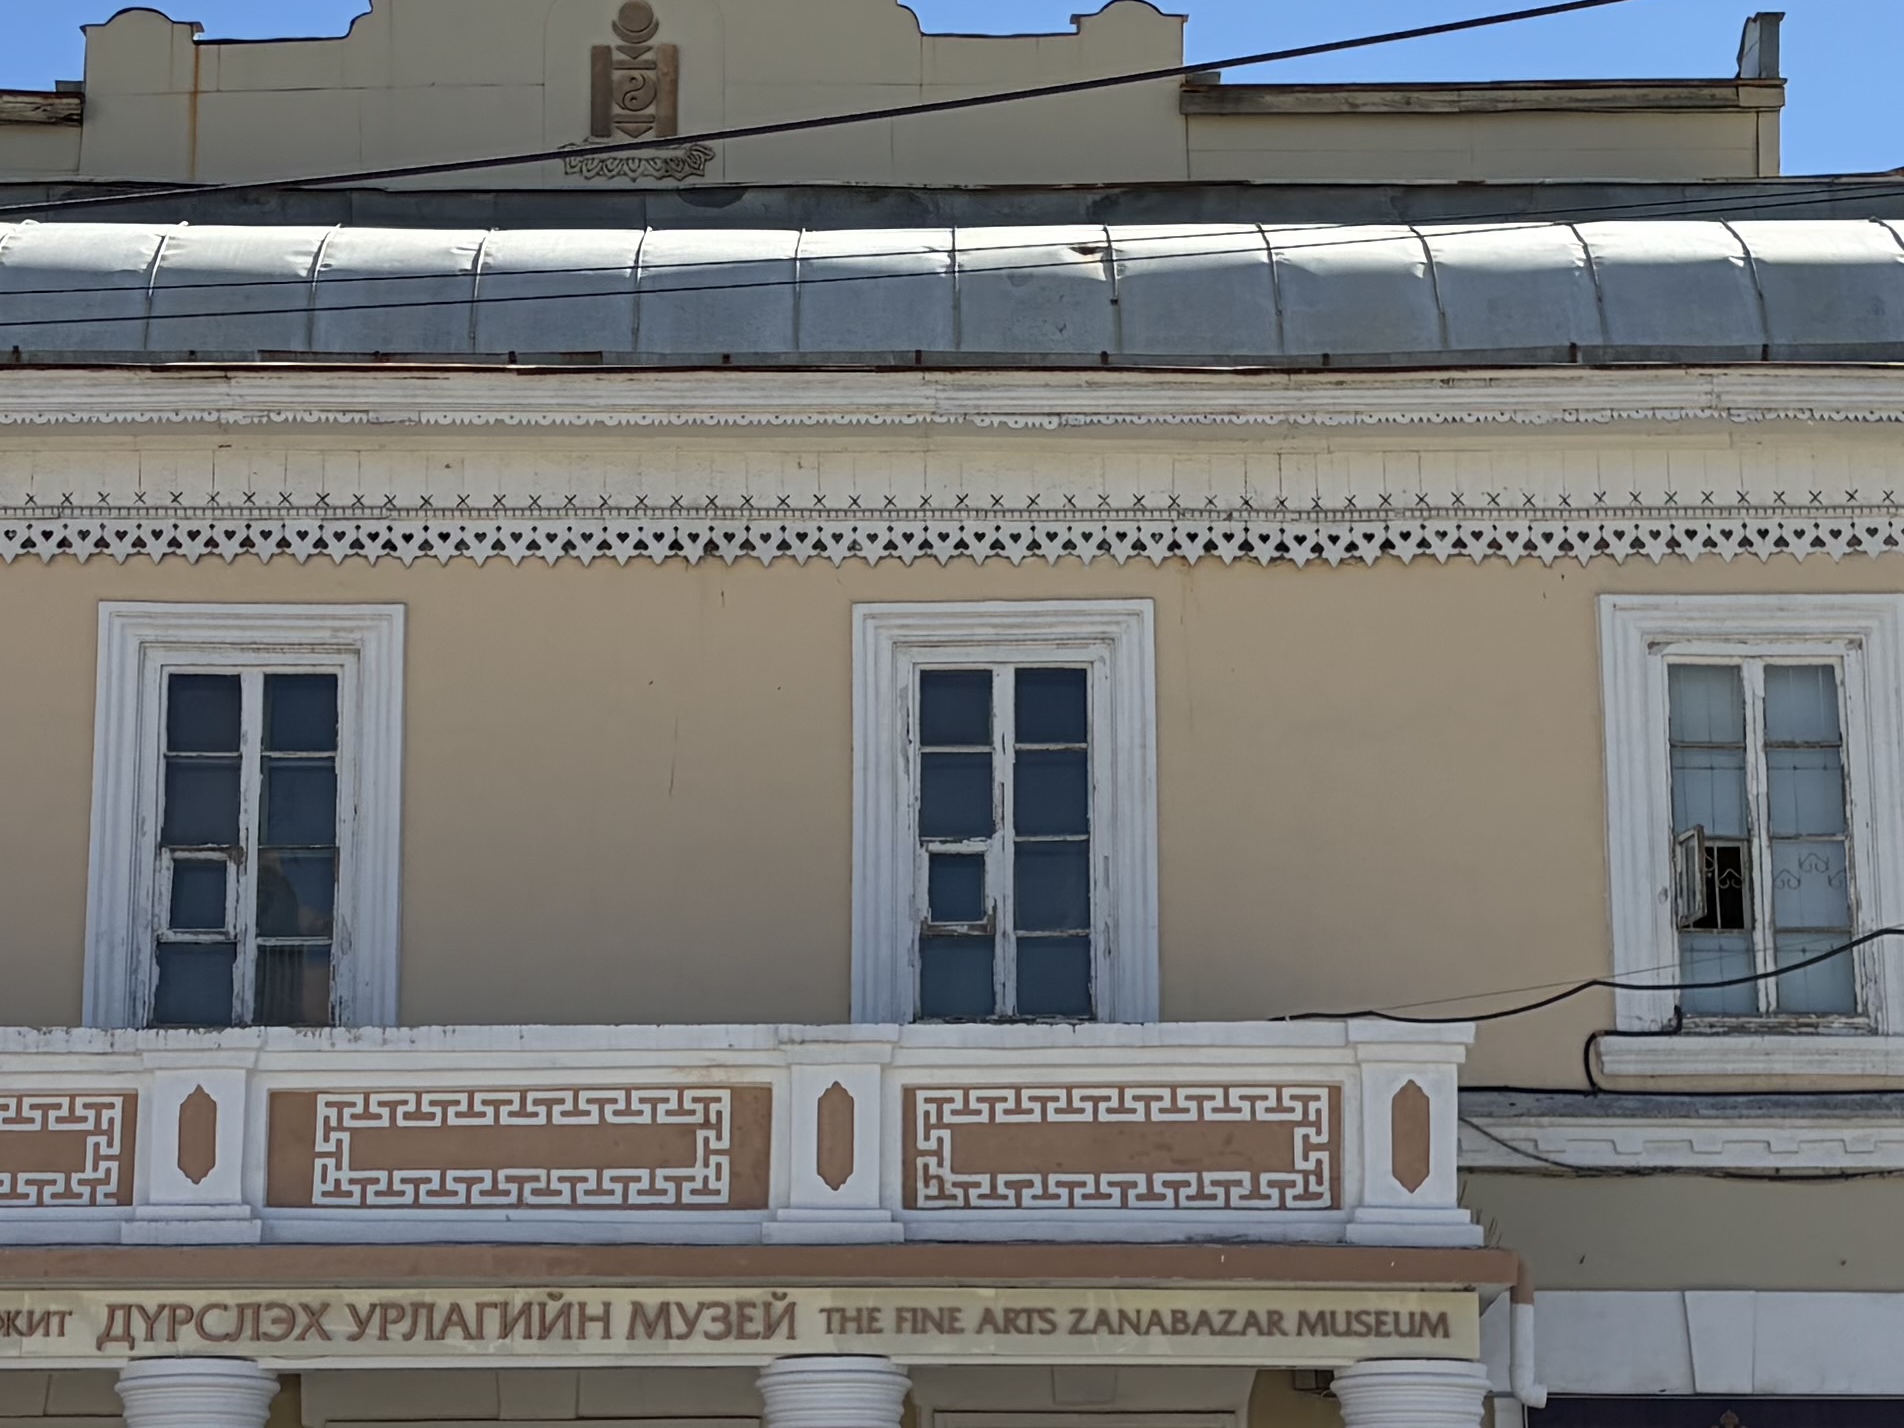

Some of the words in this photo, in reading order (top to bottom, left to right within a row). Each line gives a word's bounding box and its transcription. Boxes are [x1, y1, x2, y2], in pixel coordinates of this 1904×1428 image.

[96, 1303, 332, 1351] ДҮРСЛЭХ
[345, 1291, 612, 1342] УРЛАГИЙН
[626, 1291, 799, 1341] МУЗЕЙ
[819, 1307, 884, 1335] THE
[897, 1306, 965, 1335] FINE
[976, 1307, 1058, 1335] ARTS
[1068, 1307, 1289, 1337] ZANABAZAR
[1296, 1309, 1451, 1340] MUSEUM
